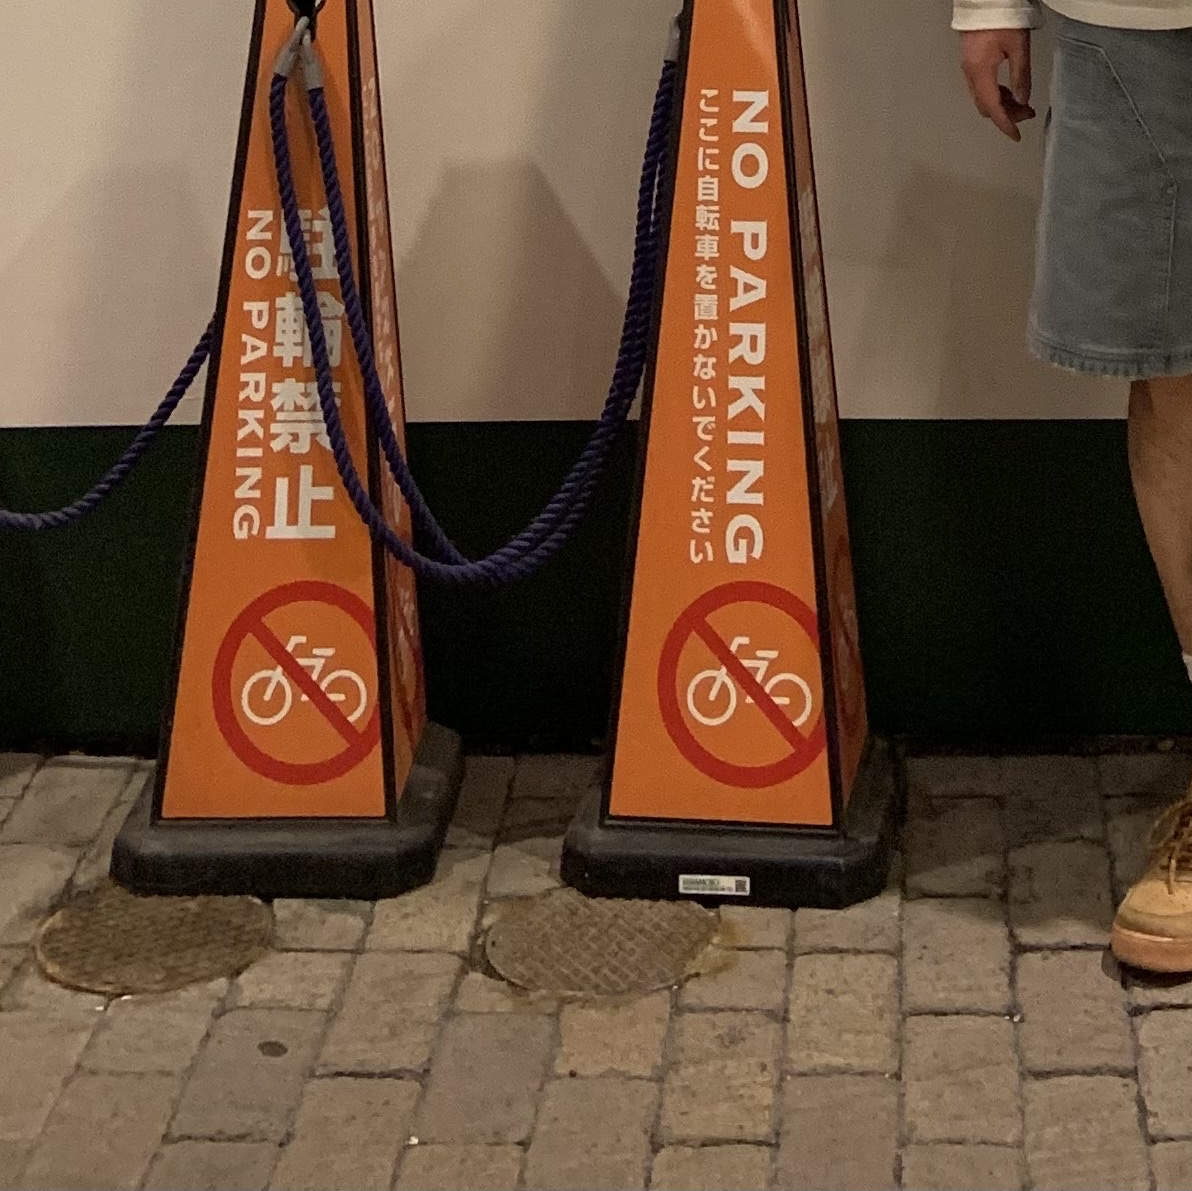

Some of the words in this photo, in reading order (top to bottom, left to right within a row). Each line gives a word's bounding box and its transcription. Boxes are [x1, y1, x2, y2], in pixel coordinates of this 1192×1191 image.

[245, 210, 274, 279] NO
[731, 90, 769, 189] NO
[233, 301, 270, 540] PARKING
[689, 89, 719, 564] ここに自転車を置かないでください
[725, 219, 768, 564] PARKING
